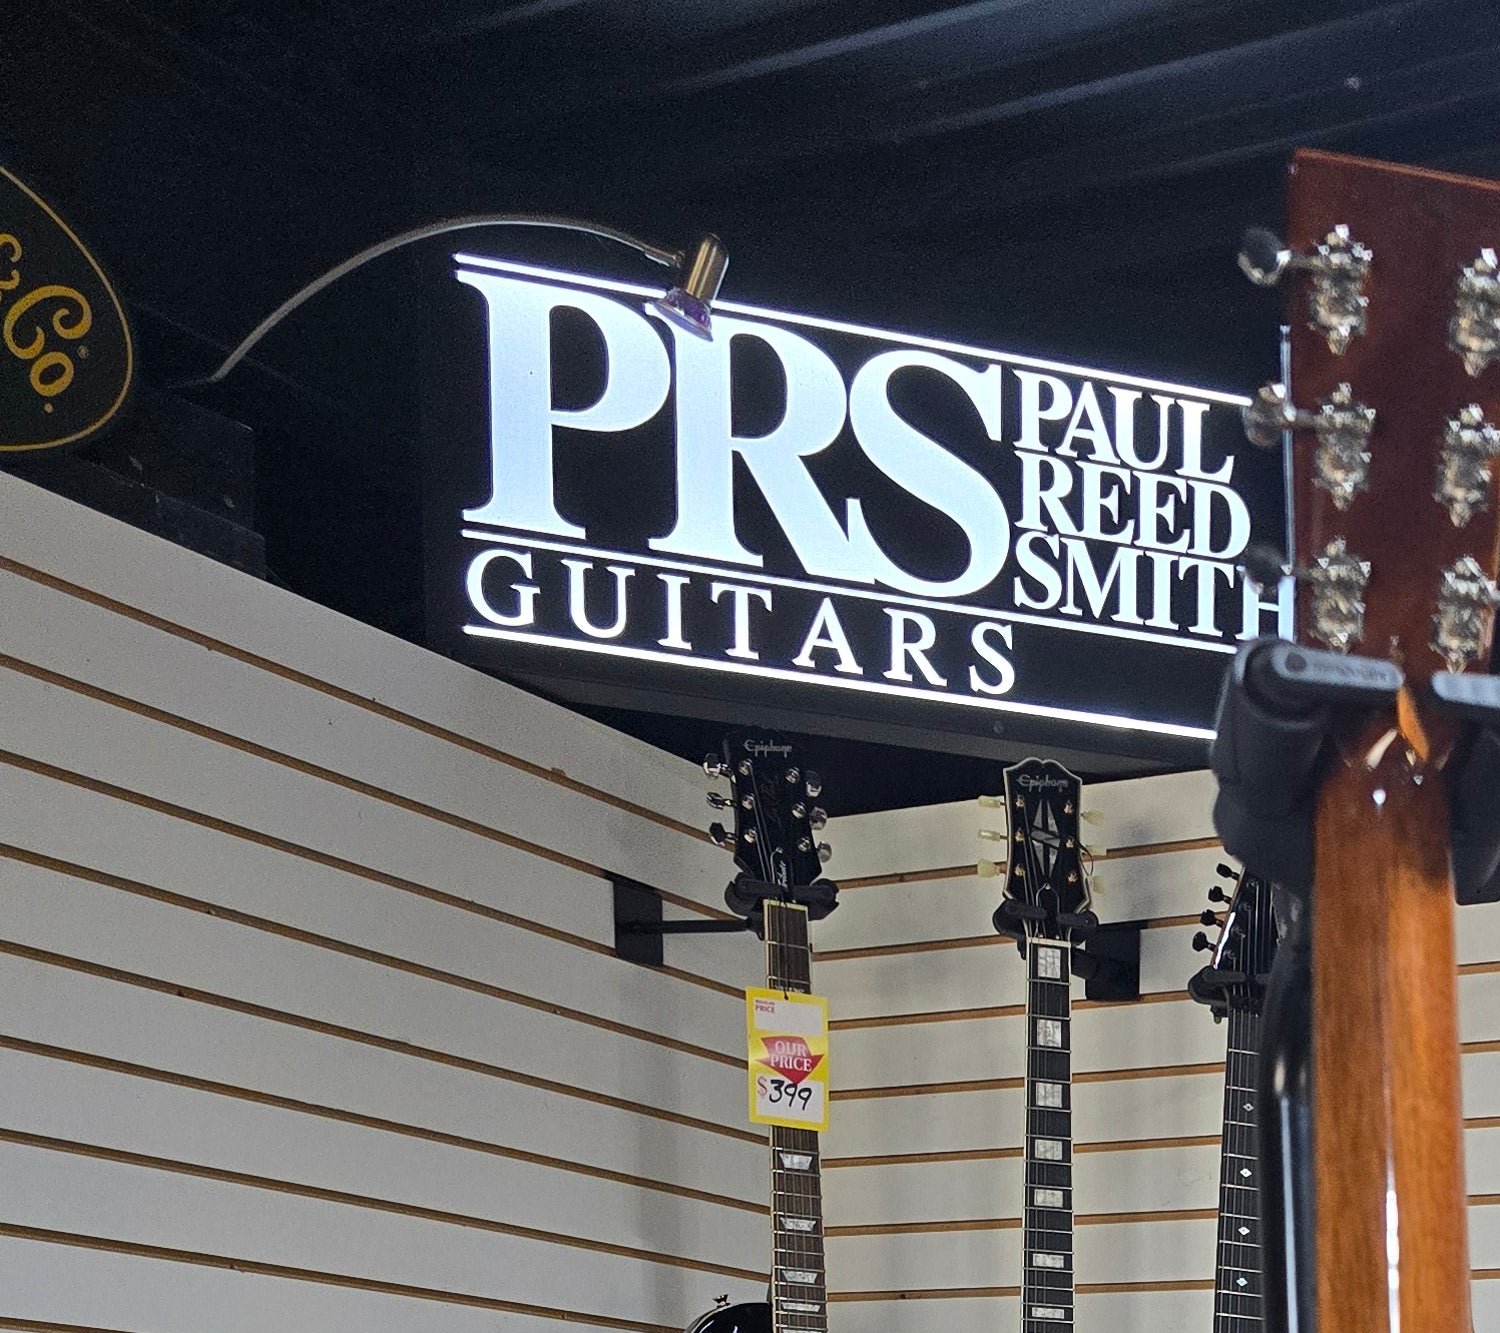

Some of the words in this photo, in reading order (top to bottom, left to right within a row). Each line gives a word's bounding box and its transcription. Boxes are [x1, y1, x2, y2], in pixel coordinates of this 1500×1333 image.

[454, 269, 1011, 598] PRS
[1011, 368, 1235, 485] PAUL
[1013, 450, 1251, 562] REED
[465, 547, 1017, 696] GUITARS
[1013, 531, 1296, 643] SMITH
[743, 738, 793, 759] Epiphone
[1015, 773, 1069, 793] Epiphone
[769, 1053, 813, 1073] PRICE
[774, 1040, 808, 1058] OUR
[756, 1076, 813, 1112] $399
